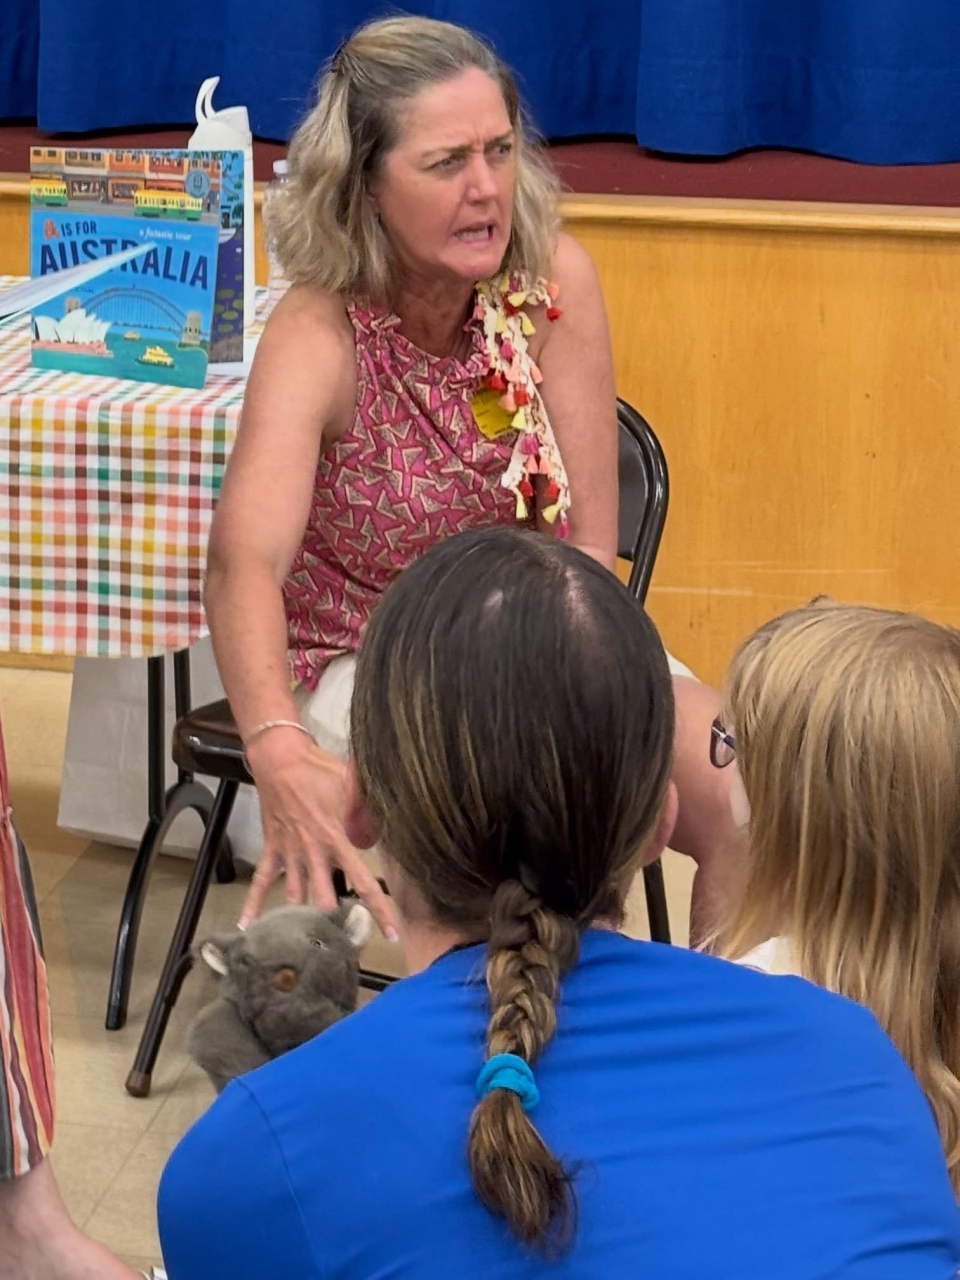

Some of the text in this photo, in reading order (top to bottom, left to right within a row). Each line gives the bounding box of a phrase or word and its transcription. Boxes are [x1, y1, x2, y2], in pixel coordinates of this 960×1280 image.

[44, 219, 97, 240] A IS FOR
[175, 230, 192, 241] tour
